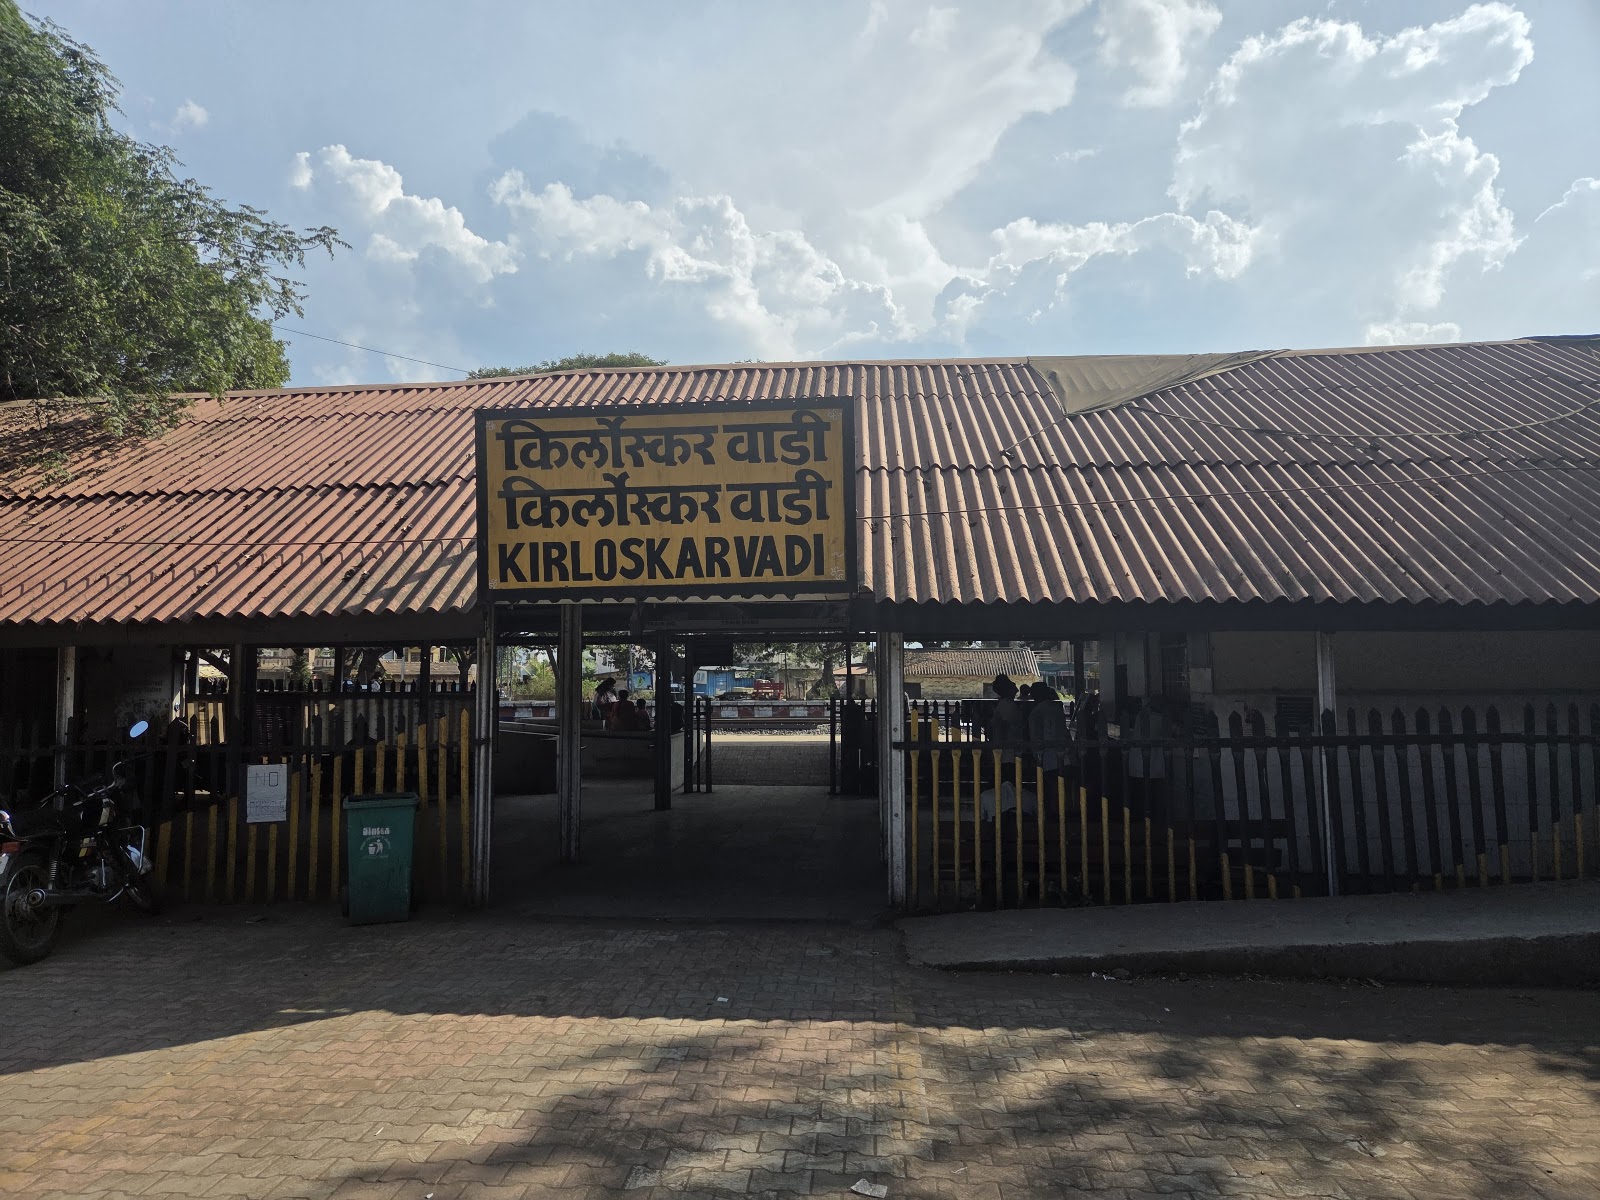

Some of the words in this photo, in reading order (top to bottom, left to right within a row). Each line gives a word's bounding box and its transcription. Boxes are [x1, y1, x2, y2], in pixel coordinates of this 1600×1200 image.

[496, 416, 719, 471] किर्लोस्कर
[723, 409, 831, 466] वाडी
[498, 471, 722, 530] किर्लोस्कर
[726, 469, 832, 526] वाडी
[499, 533, 825, 583] KIRLOSKARVADI
[255, 771, 279, 787] NO
